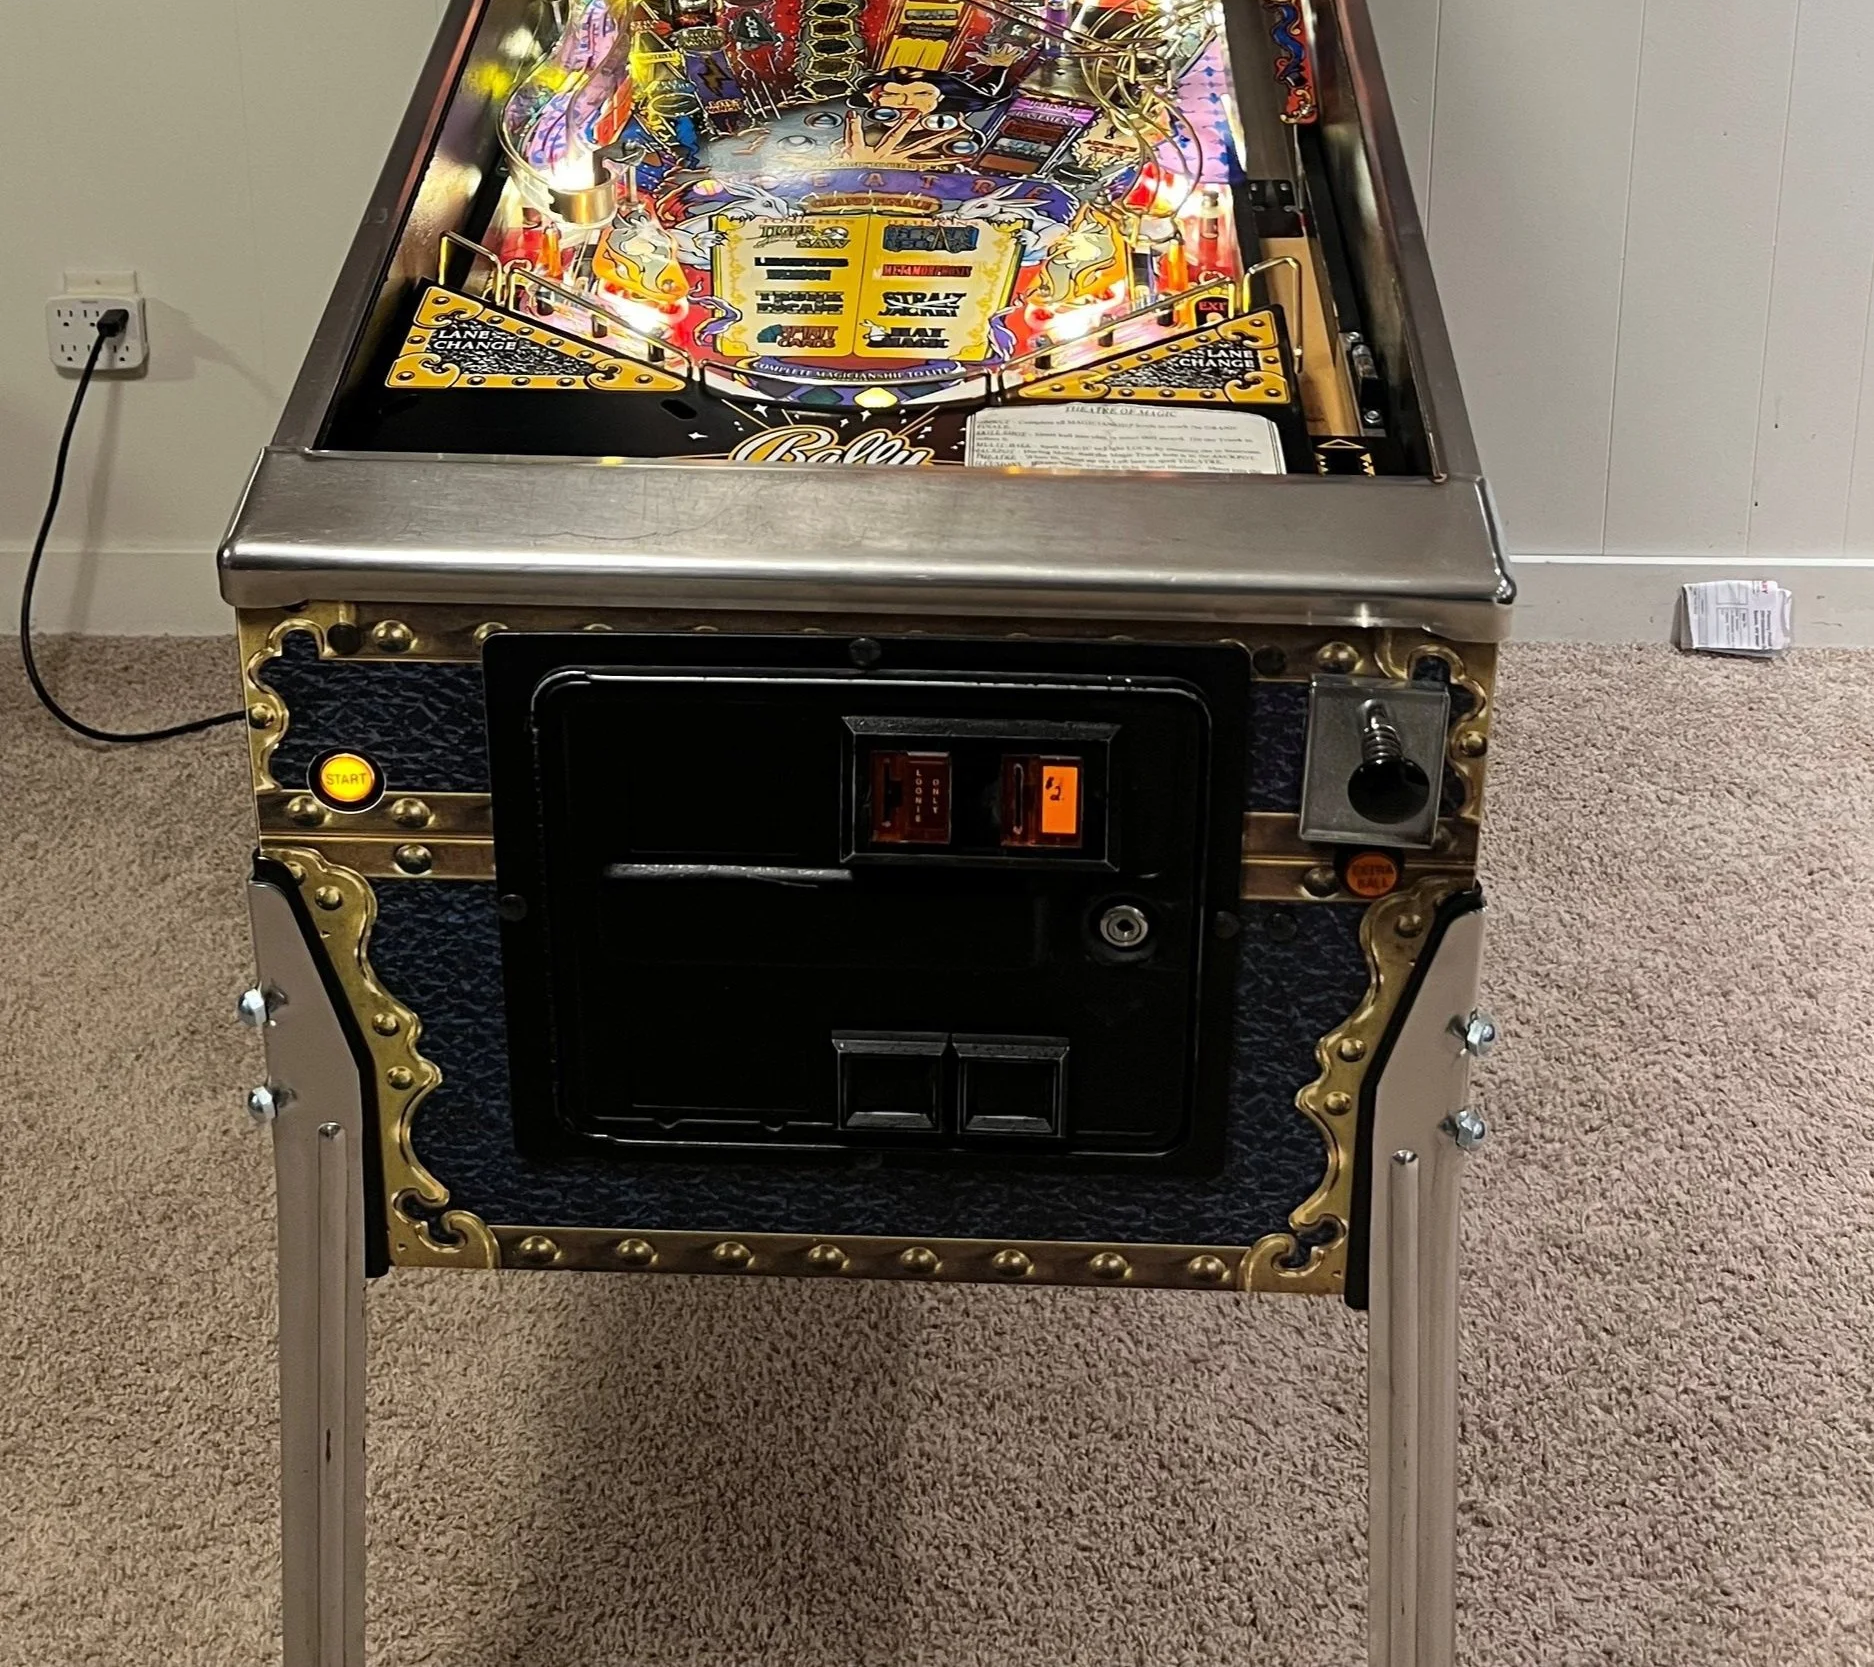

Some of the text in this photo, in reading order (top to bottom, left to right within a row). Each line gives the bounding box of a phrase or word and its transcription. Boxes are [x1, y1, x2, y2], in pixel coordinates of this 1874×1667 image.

[796, 239, 851, 249] SAW
[438, 329, 491, 340] LANE
[433, 340, 518, 350] CHANGE
[1207, 349, 1255, 359] LANE
[1180, 358, 1255, 368] CHANGE
[752, 361, 812, 377] COMPLETE
[1065, 406, 1117, 415] THEATRE
[326, 772, 367, 786] START
[932, 778, 940, 814] ONLY
